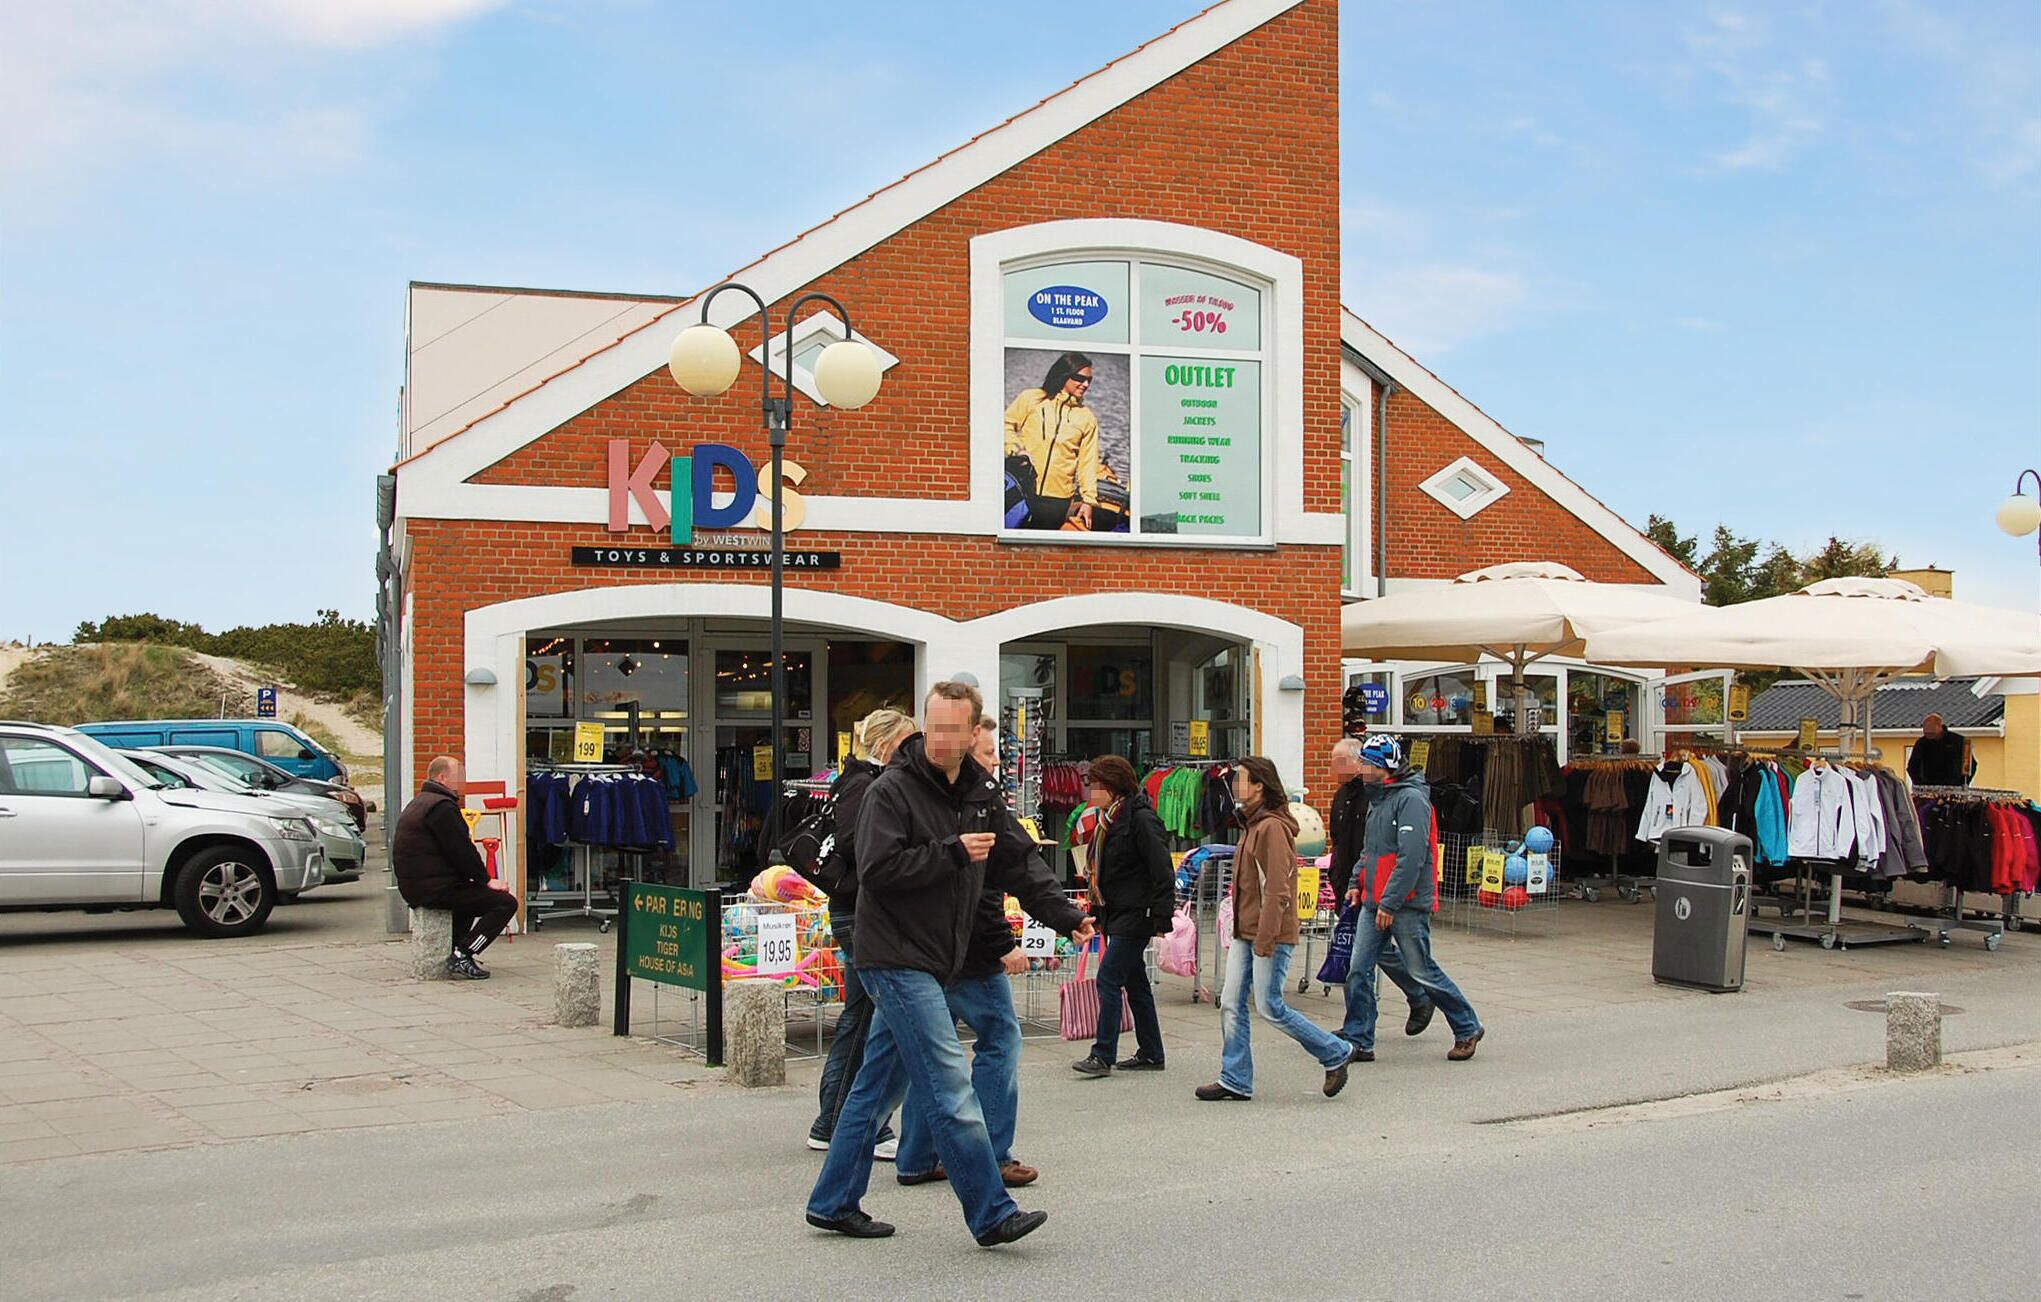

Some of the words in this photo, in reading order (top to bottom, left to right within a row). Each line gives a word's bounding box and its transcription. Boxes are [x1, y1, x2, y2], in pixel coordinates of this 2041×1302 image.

[1036, 293, 1051, 304] ON
[1053, 294, 1072, 306] THE
[1074, 295, 1099, 307] PEAK
[1066, 308, 1085, 316] FLOOR
[1172, 310, 1227, 334] -50%
[1165, 364, 1236, 388] OUTLET
[1180, 399, 1218, 408] OUTDOOR
[1183, 416, 1217, 426] JACKETS
[1167, 435, 1206, 445] RUNNING
[1207, 437, 1232, 446] WEAR
[1180, 454, 1221, 464] TRACKING
[1187, 474, 1213, 483] SHOES
[608, 439, 808, 545] KIDS
[1179, 491, 1197, 500] SOFT
[1199, 492, 1221, 501] SHELL
[1198, 515, 1225, 524] PACKS
[696, 534, 709, 546] by
[712, 534, 772, 546] WESTWIN
[594, 550, 647, 562] TOYS
[659, 551, 671, 563] &
[683, 553, 820, 566] SPORTSWEAR
[262, 690, 272, 698] P
[1413, 697, 1425, 709] 10
[578, 742, 596, 756] 199
[1026, 937, 1045, 949] 29
[1332, 931, 1353, 945] EST
[656, 940, 679, 957] TIGER
[763, 939, 792, 966] 19,95
[639, 955, 664, 971] HOUSE
[665, 960, 676, 974] OF
[677, 962, 695, 977] ASIA
